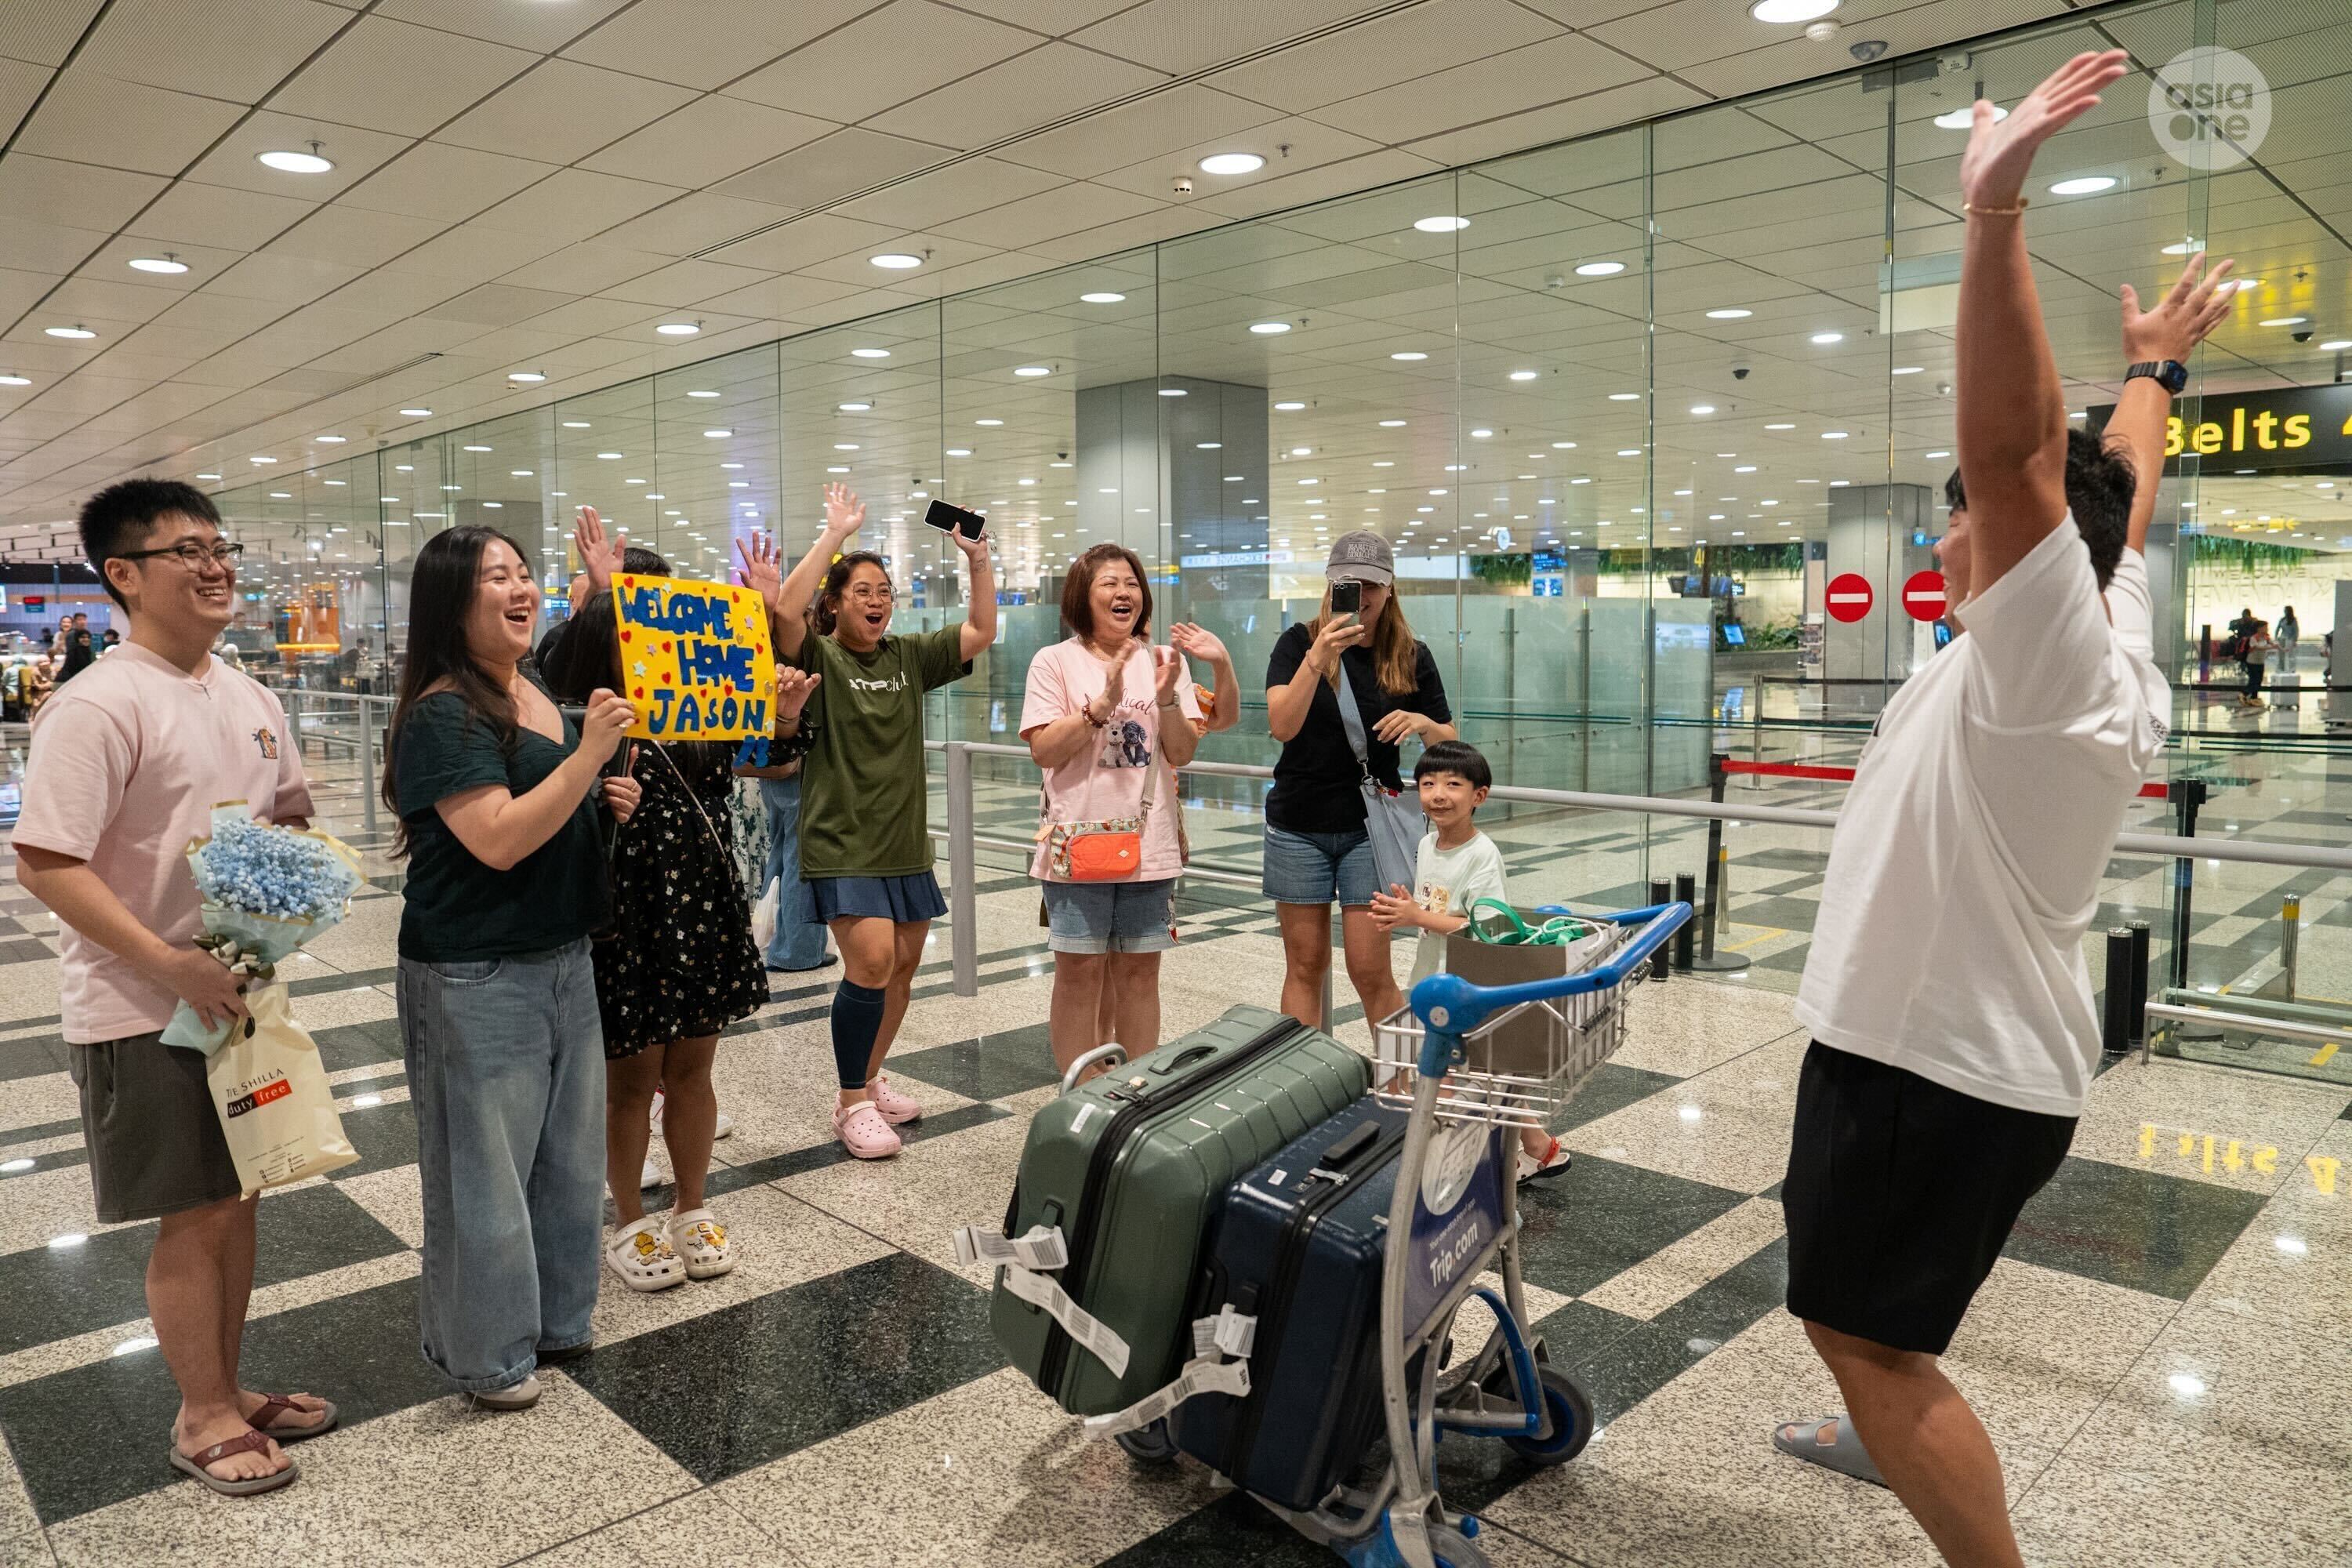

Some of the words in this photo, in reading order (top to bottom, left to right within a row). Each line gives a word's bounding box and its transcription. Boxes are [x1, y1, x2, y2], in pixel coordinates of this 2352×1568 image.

[2164, 408, 2311, 456] Belts
[618, 586, 733, 640] WELCOME
[677, 639, 755, 692] HOME
[649, 689, 765, 735] JASON
[228, 1098, 253, 1115] duty
[259, 1085, 287, 1102] free
[241, 1068, 285, 1092] SHILLA
[1429, 1222, 1478, 1288] Trip.com
